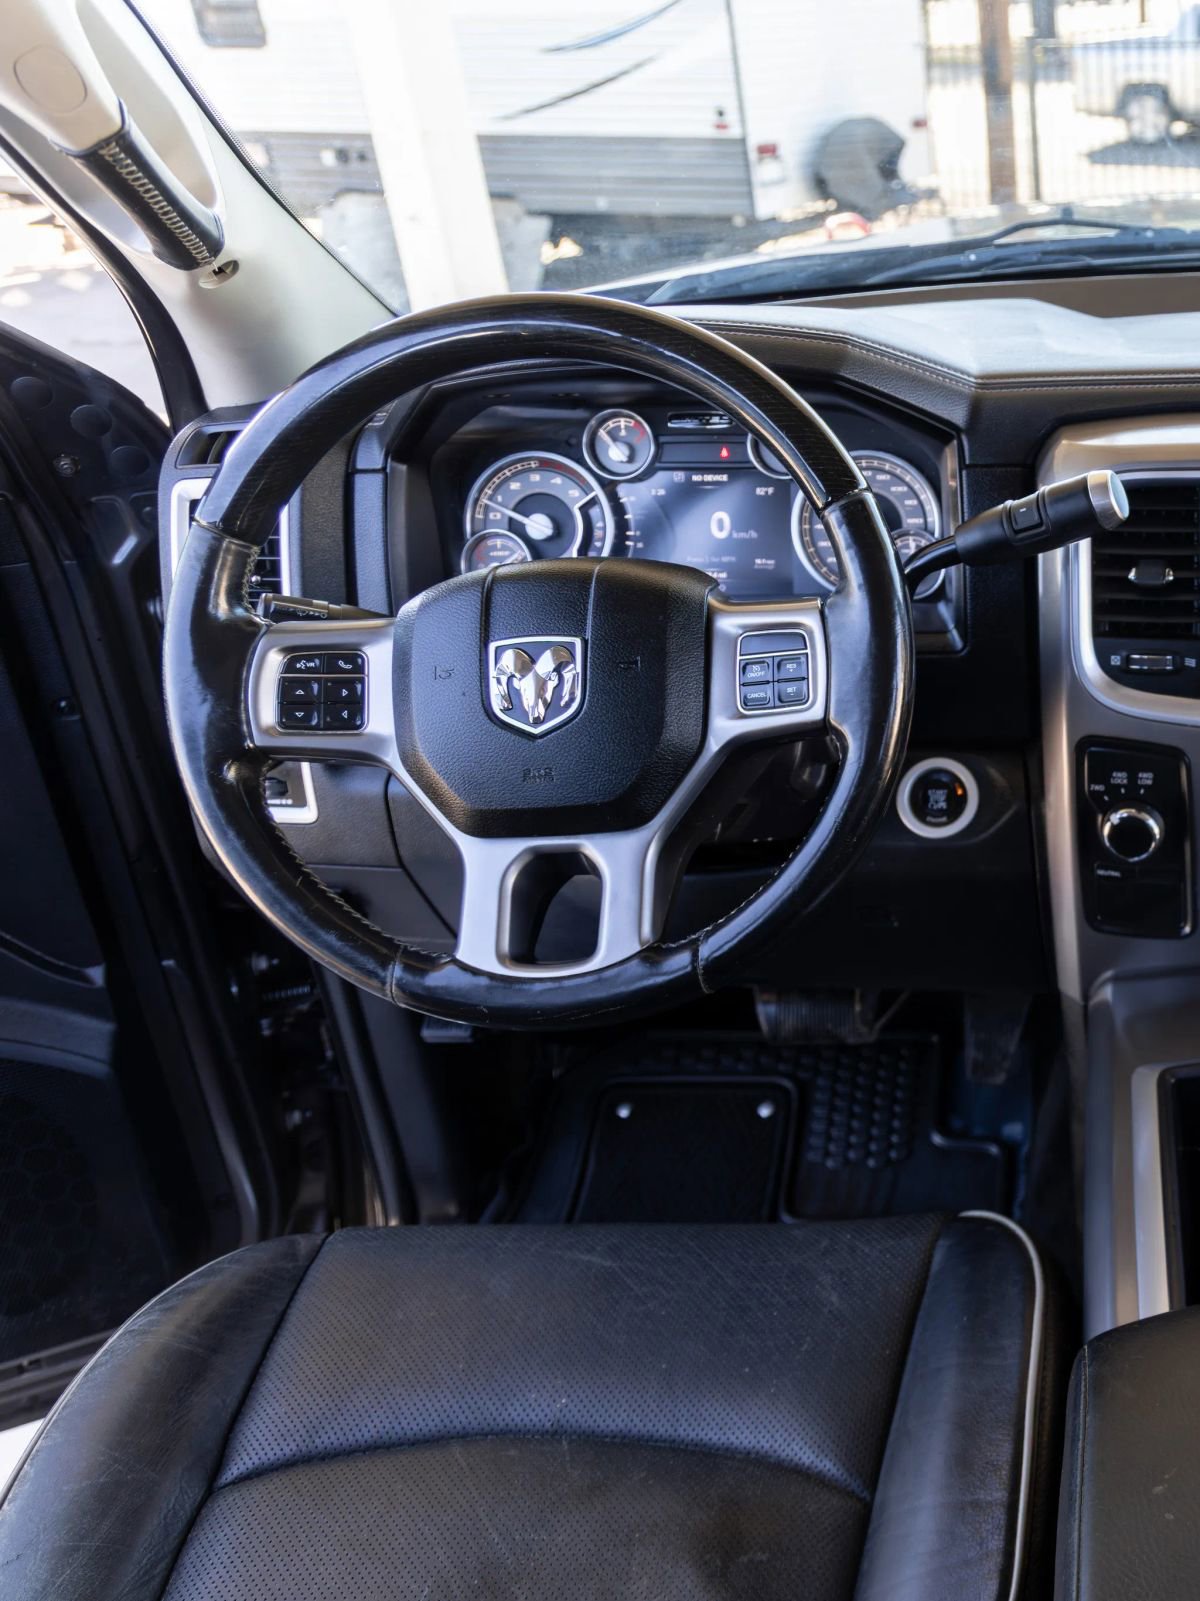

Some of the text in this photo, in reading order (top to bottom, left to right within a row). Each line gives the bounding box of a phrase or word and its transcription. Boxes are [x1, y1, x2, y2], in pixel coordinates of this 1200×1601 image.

[529, 474, 541, 482] 3
[691, 474, 728, 482] NO DEVICE
[509, 482, 521, 490] 2
[710, 511, 731, 539] 0
[732, 530, 758, 539] km/h
